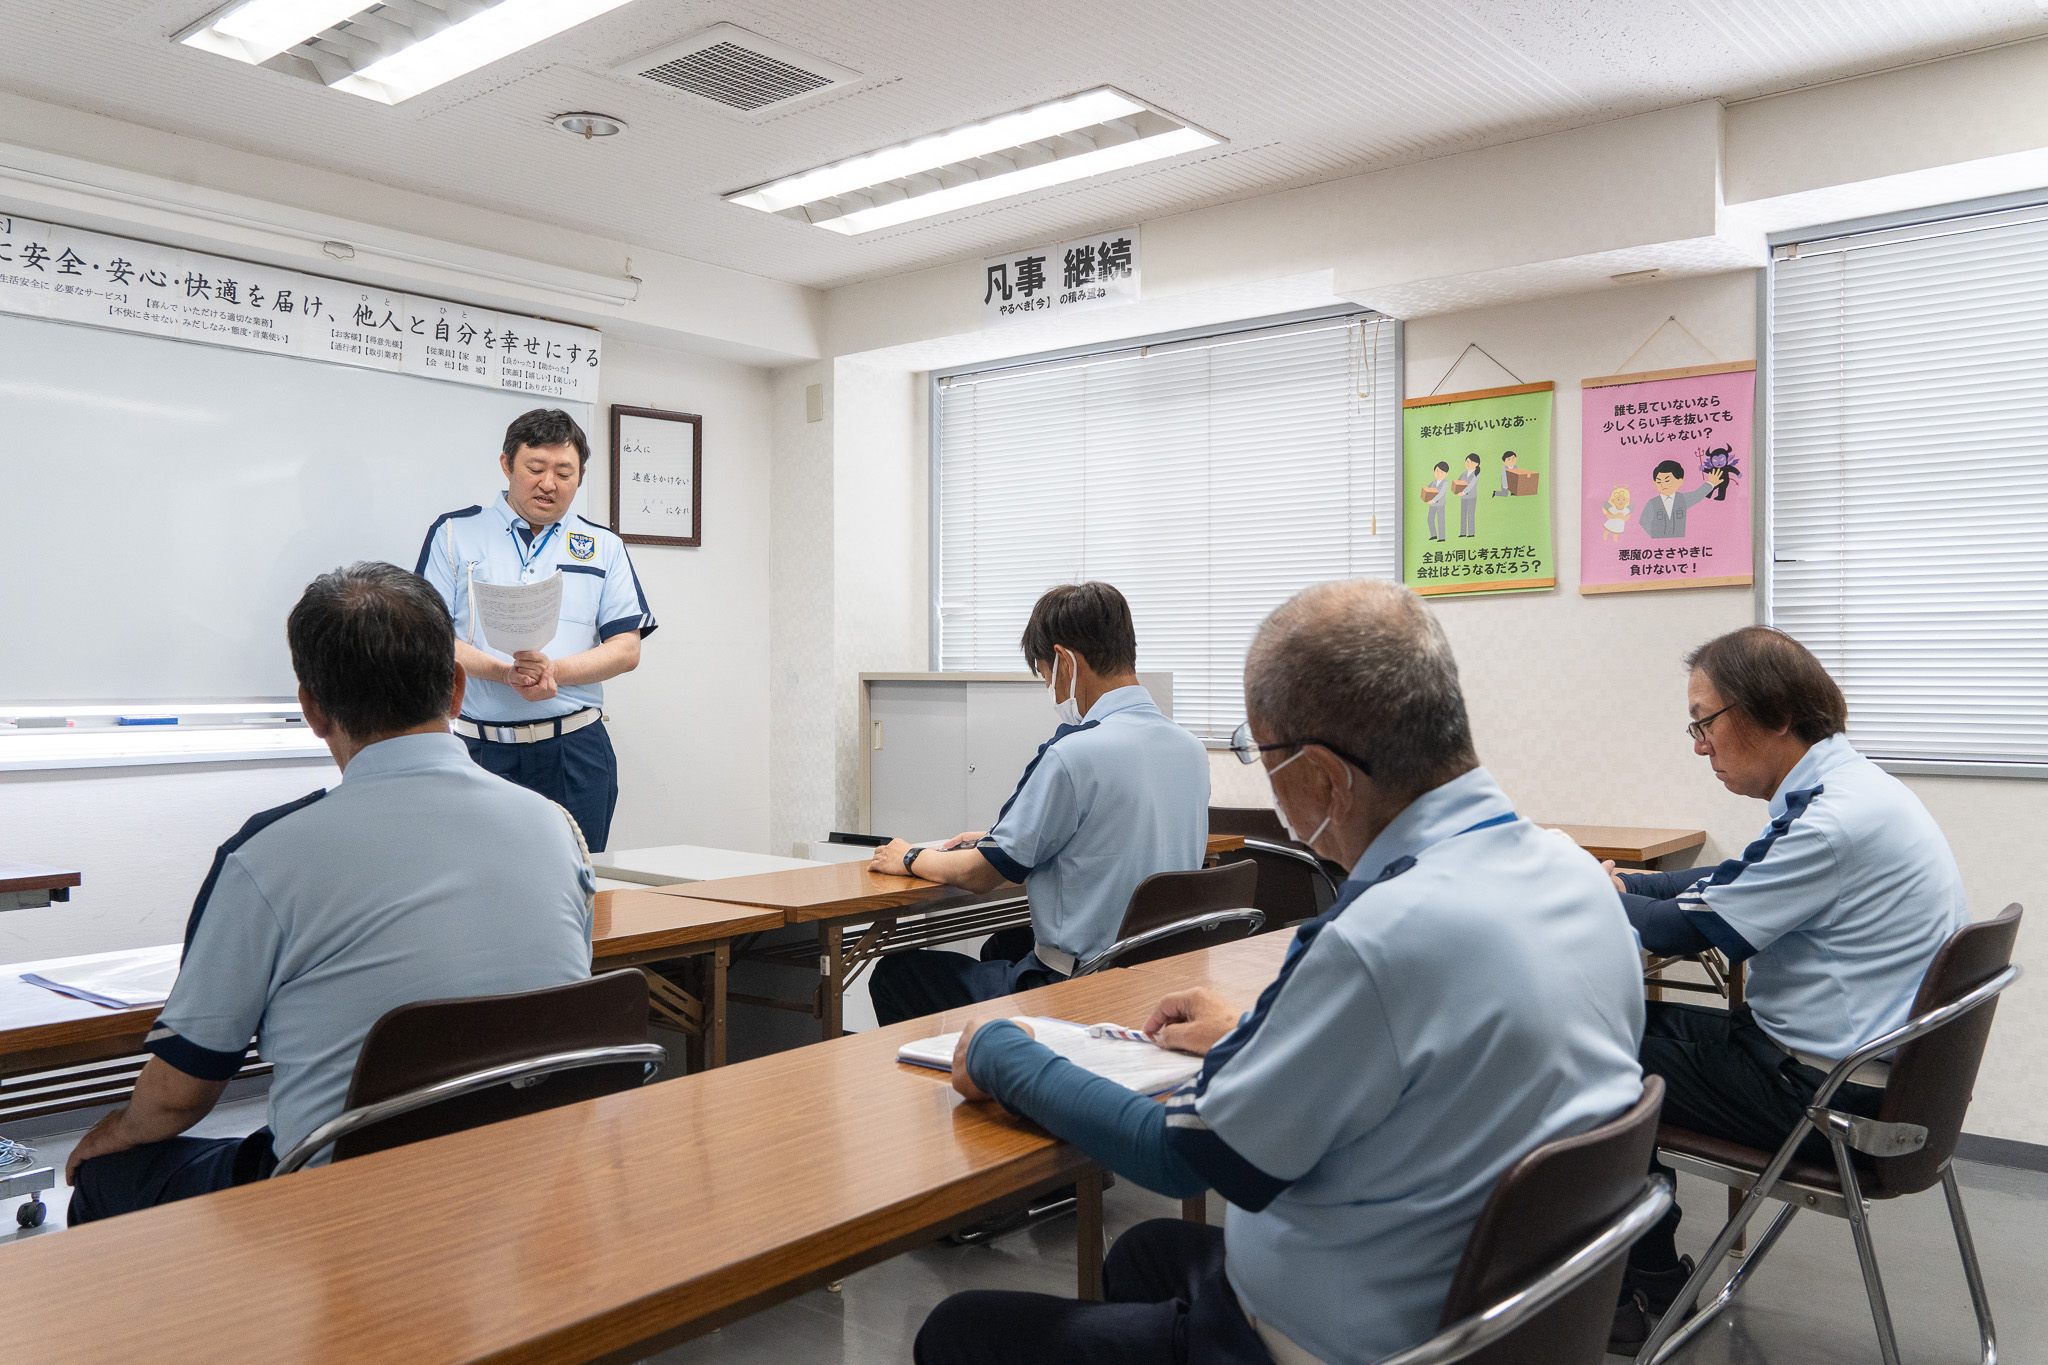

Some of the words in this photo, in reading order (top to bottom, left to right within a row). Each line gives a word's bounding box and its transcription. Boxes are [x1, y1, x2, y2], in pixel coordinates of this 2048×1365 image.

[984, 256, 1046, 305] 凡事
[1064, 238, 1132, 289] 継続
[54, 283, 127, 303] 必要なサービス】
[1000, 296, 1051, 315] やるべき【今】
[1060, 287, 1106, 304] の積み重ね
[109, 305, 178, 324] 【不快にさせない
[1614, 396, 1721, 417] 誰も見ていないなら
[1420, 415, 1537, 438] 楽な仕事がいいなあ…
[1603, 410, 1734, 433] 少しくらい手を抜いても
[1620, 427, 1713, 446] いいんじゃない？
[1422, 546, 1536, 564] 全員が同じ考え方だと
[1619, 547, 1713, 561] 悪魔のささやきに
[1417, 560, 1542, 579] 会社はどうなるだろう？
[1630, 562, 1697, 576] 負けないで！
